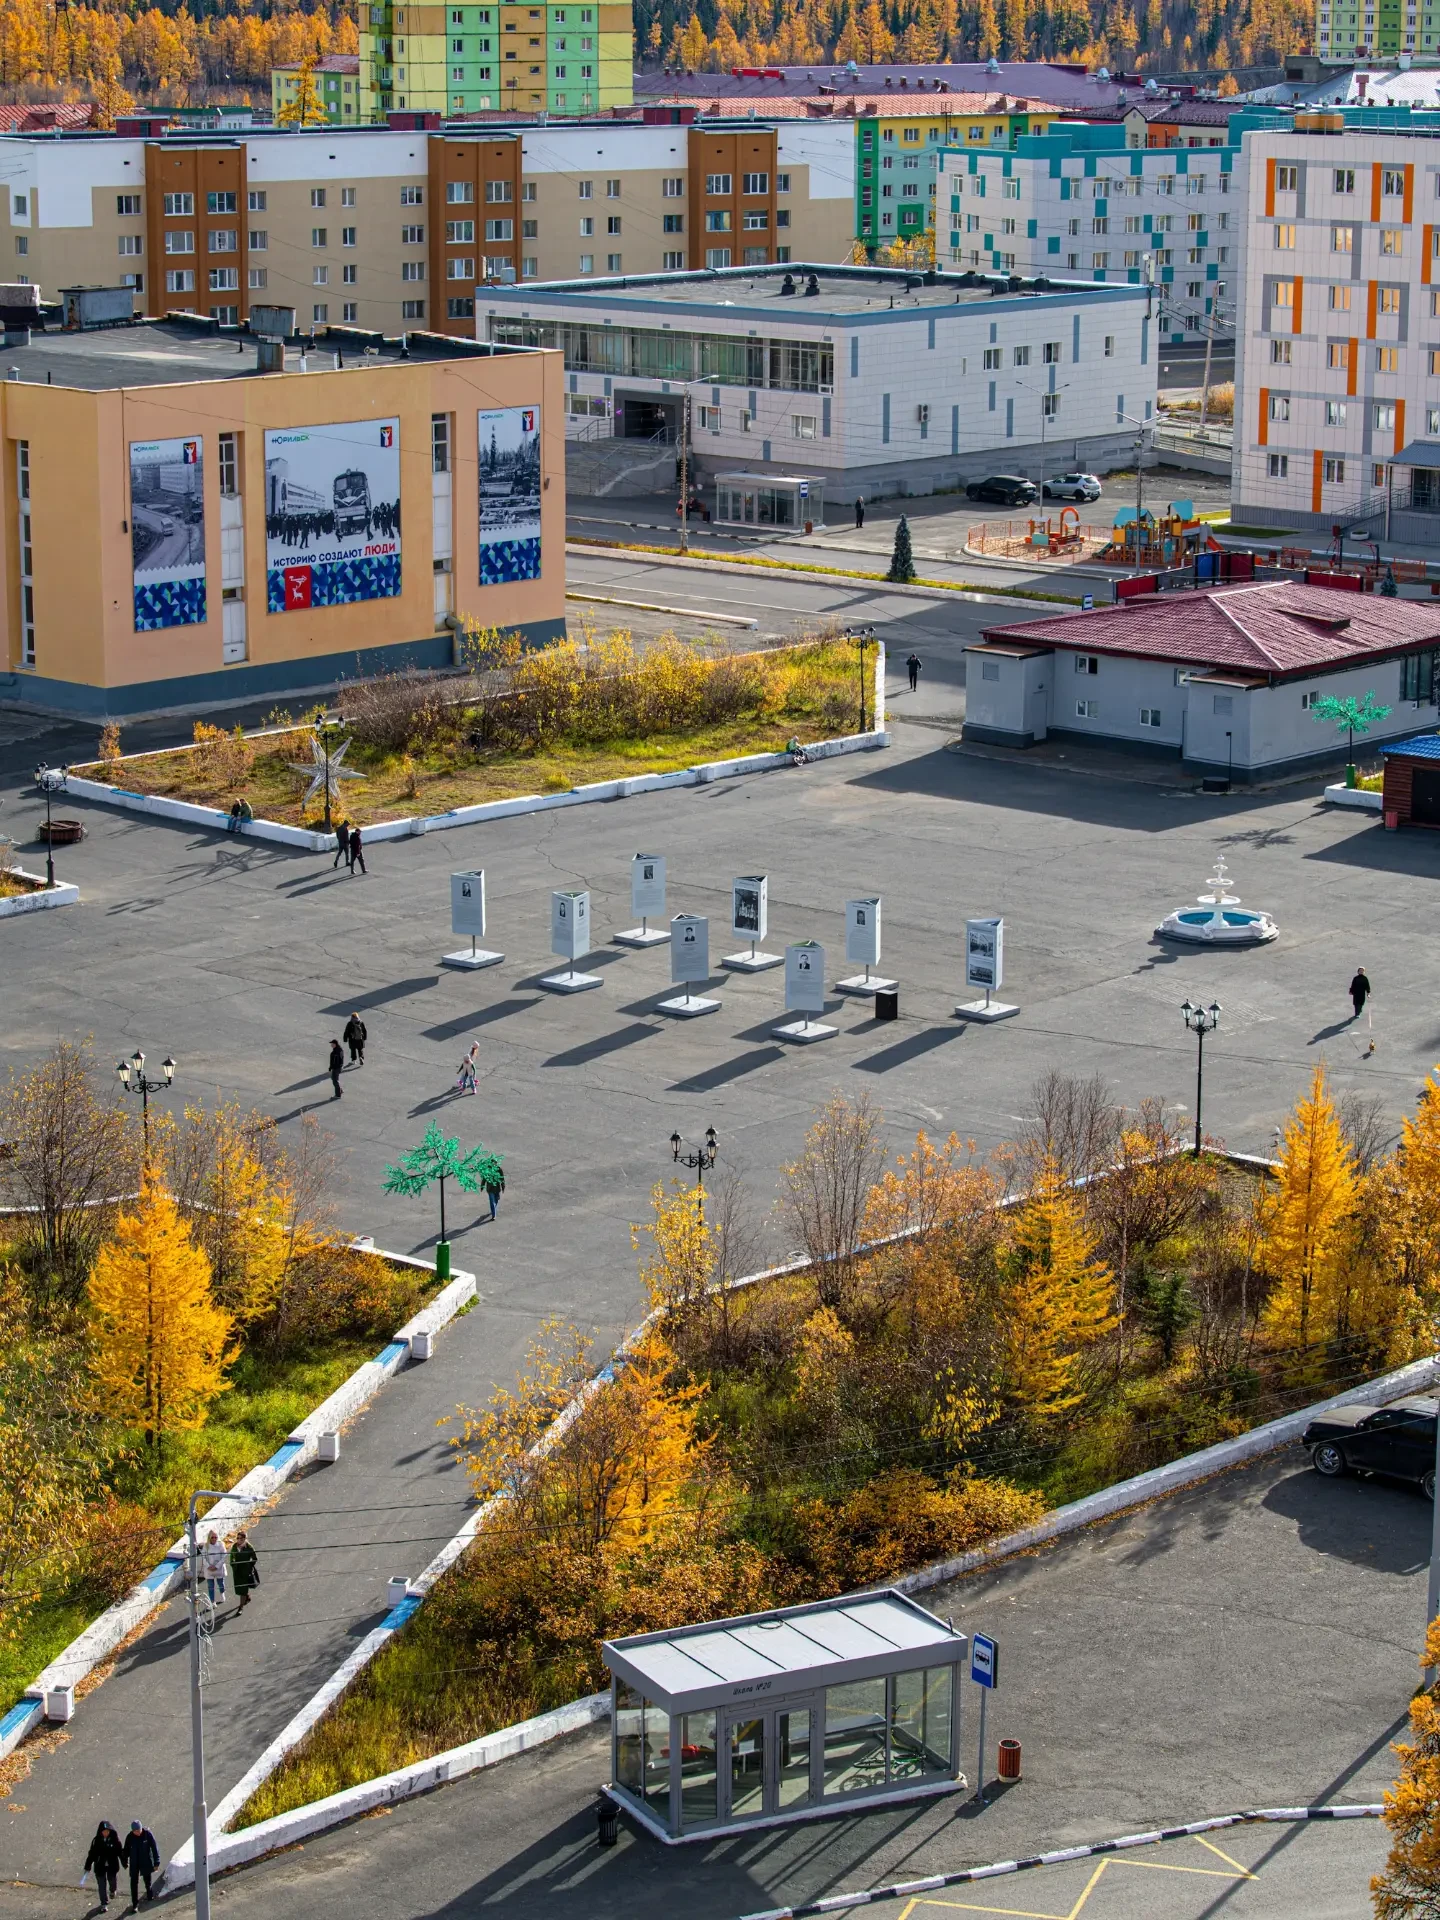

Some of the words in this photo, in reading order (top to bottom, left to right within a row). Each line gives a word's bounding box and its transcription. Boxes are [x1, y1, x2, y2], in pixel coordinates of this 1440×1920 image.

[271, 434, 310, 445] НОРИЛЬСК
[273, 554, 317, 567] ИСТОРИЮ
[318, 548, 363, 563] СОЗДАЮТ
[364, 542, 396, 556] ЛЮДИ
